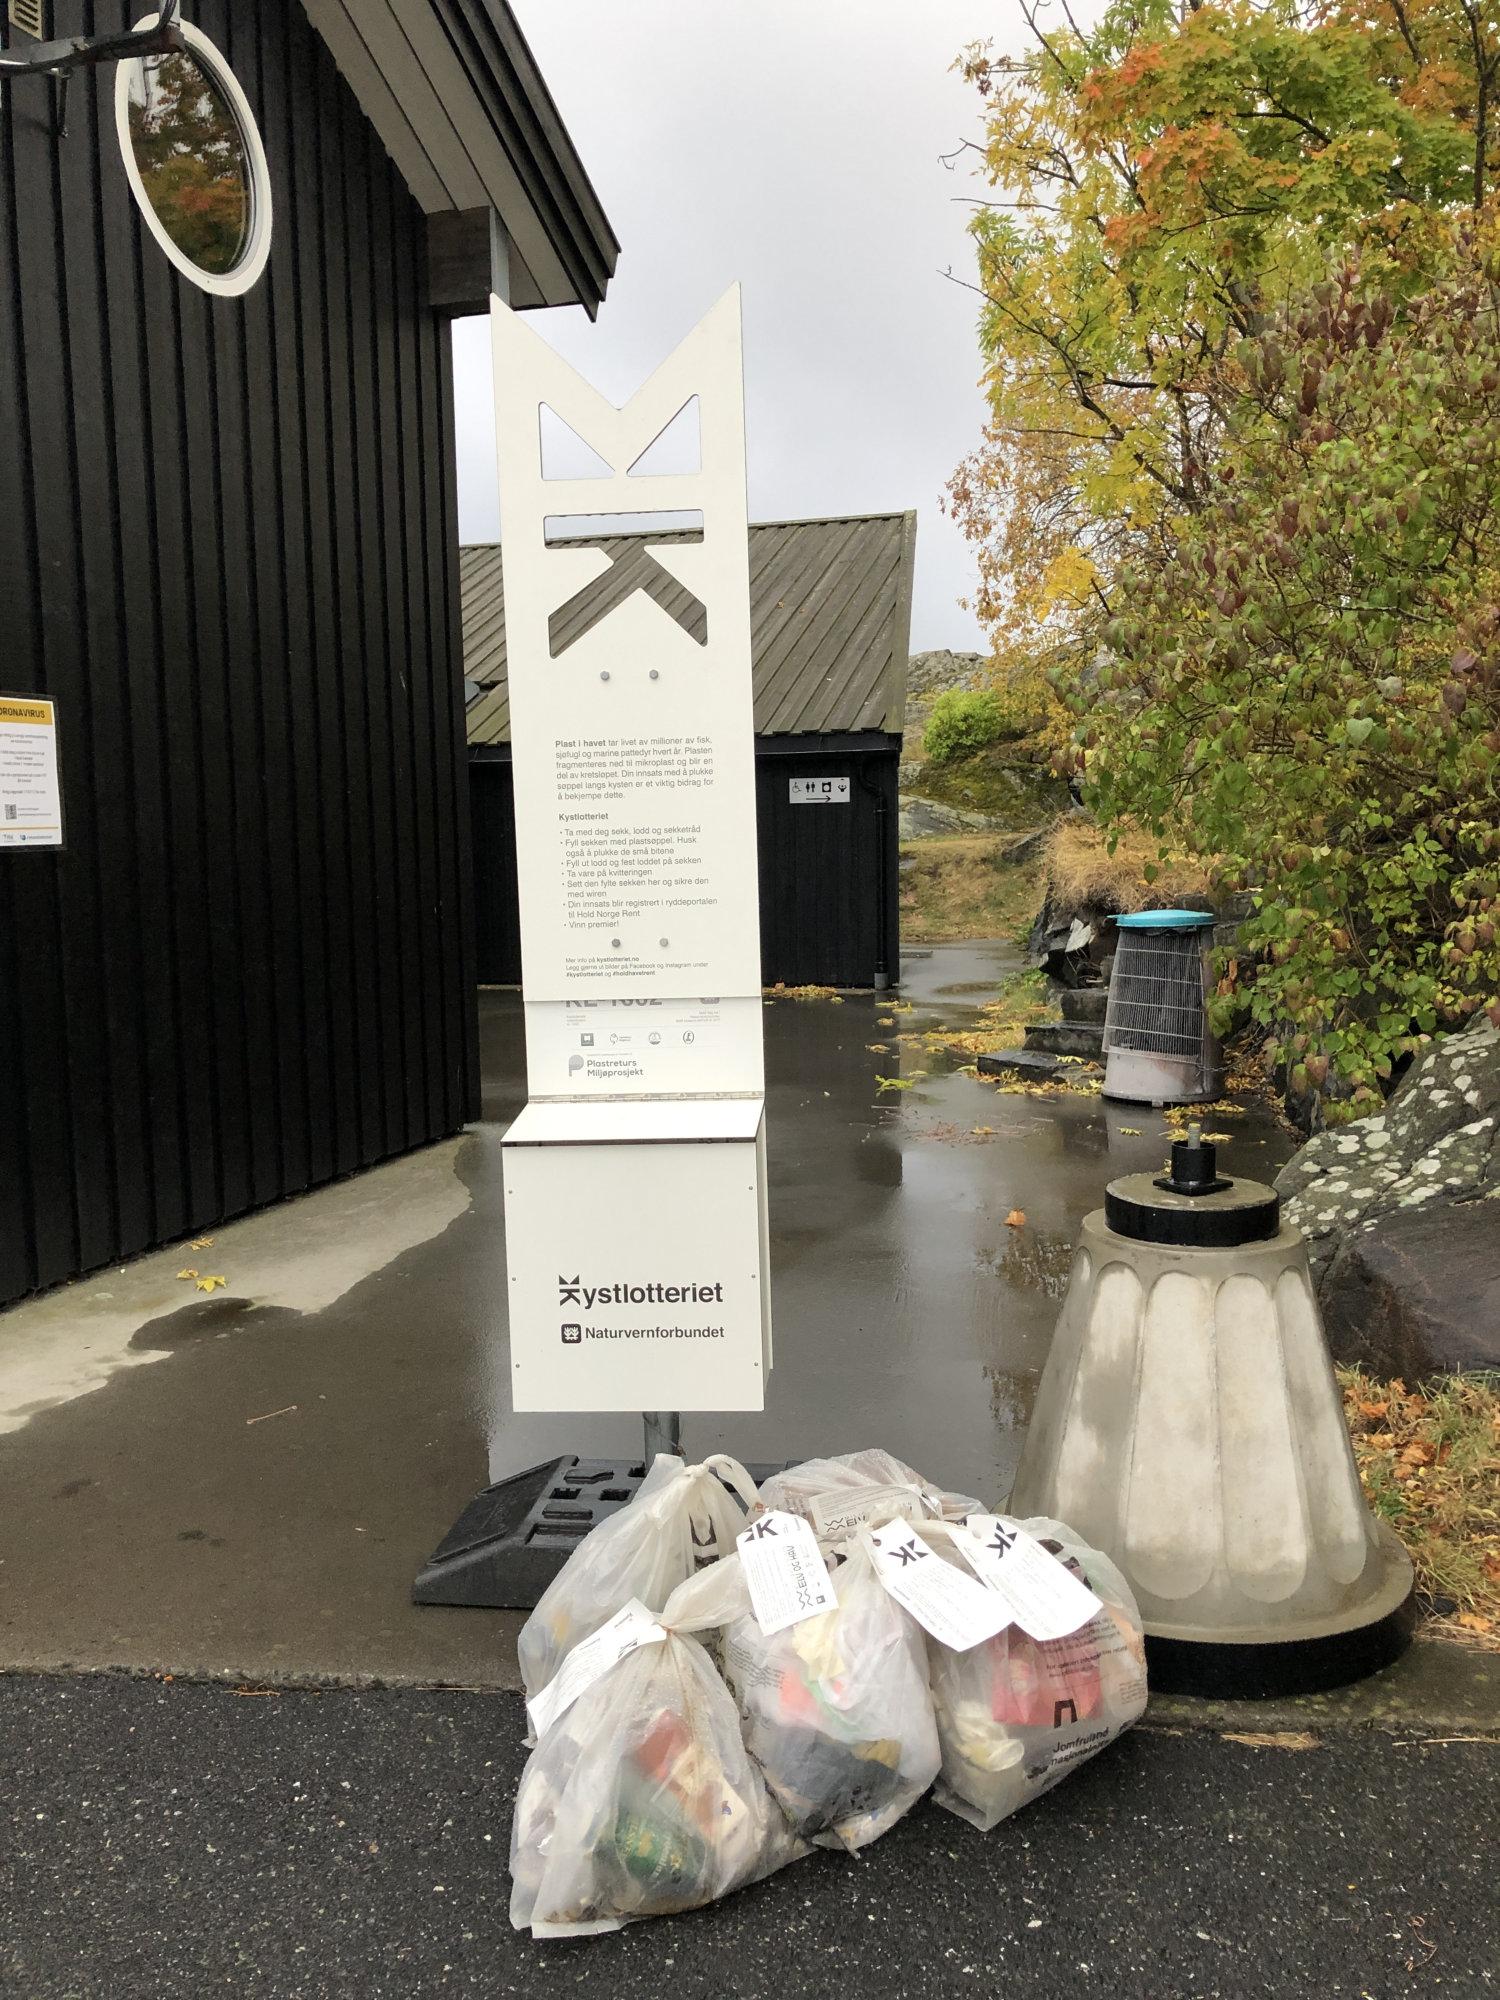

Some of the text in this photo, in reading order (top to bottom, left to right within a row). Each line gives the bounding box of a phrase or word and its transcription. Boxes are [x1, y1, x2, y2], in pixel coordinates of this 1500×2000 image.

[555, 739, 576, 747] Plast
[583, 738, 606, 747] havet
[608, 738, 618, 746] tar
[620, 737, 637, 746] livet
[650, 736, 683, 745] millioner
[555, 750, 581, 760] sjøfugl
[581, 751, 592, 760] og
[593, 748, 619, 757] marine
[620, 748, 651, 758] pattedyr
[652, 747, 672, 755] hvert
[684, 746, 713, 755] Plasten
[556, 759, 607, 771] fragmenteres
[609, 759, 624, 767] ned
[634, 758, 674, 769] mikroplast
[676, 759, 687, 768] og
[688, 757, 701, 765] blir
[556, 771, 568, 779] del
[621, 769, 634, 777] Din
[635, 768, 663, 777] innsats
[664, 768, 681, 776] med
[682, 767, 688, 776] å
[688, 767, 714, 778] plukke
[557, 781, 583, 792] søppel
[585, 780, 606, 791] langs
[608, 780, 633, 790] kysten
[645, 779, 653, 787] et
[654, 778, 675, 789] viktig
[677, 778, 701, 789] bidrag
[703, 778, 714, 786] for
[557, 791, 563, 800] å
[564, 791, 602, 802] bekjempe
[558, 812, 608, 822] Kystlotteriet
[564, 828, 574, 836] Ta
[575, 827, 593, 835] med
[594, 827, 609, 837] deg
[633, 826, 650, 834] lodd
[651, 828, 662, 836] og
[663, 825, 701, 834] sekketråd
[565, 838, 579, 848] Fyll
[580, 838, 608, 846] sekken
[609, 837, 627, 845] med
[676, 836, 696, 844] Husk
[565, 846, 674, 859] også å plukke de små bitene
[566, 856, 702, 869] Fyll ut lodd og fest loddet på sekken
[566, 869, 576, 877] Ta
[596, 868, 607, 879] på
[608, 868, 652, 878] kvitteringen
[567, 876, 709, 889] Sett den fylte sekken her og sikre den
[567, 900, 581, 908] Din
[582, 899, 610, 907] innsats
[611, 899, 624, 907] blir
[625, 898, 660, 909] registrert
[665, 897, 718, 908] ryddeportalen
[576, 910, 594, 918] Hold
[596, 909, 620, 920] Norge
[622, 909, 640, 917] Rent
[568, 920, 586, 928] Vinn
[586, 1059, 637, 1068] Plastreturs
[587, 1068, 644, 1079] Miljøprosjekt
[585, 1326, 725, 1340] Naturvernforbundet
[1053, 1727, 1109, 1753] Jomfruland
